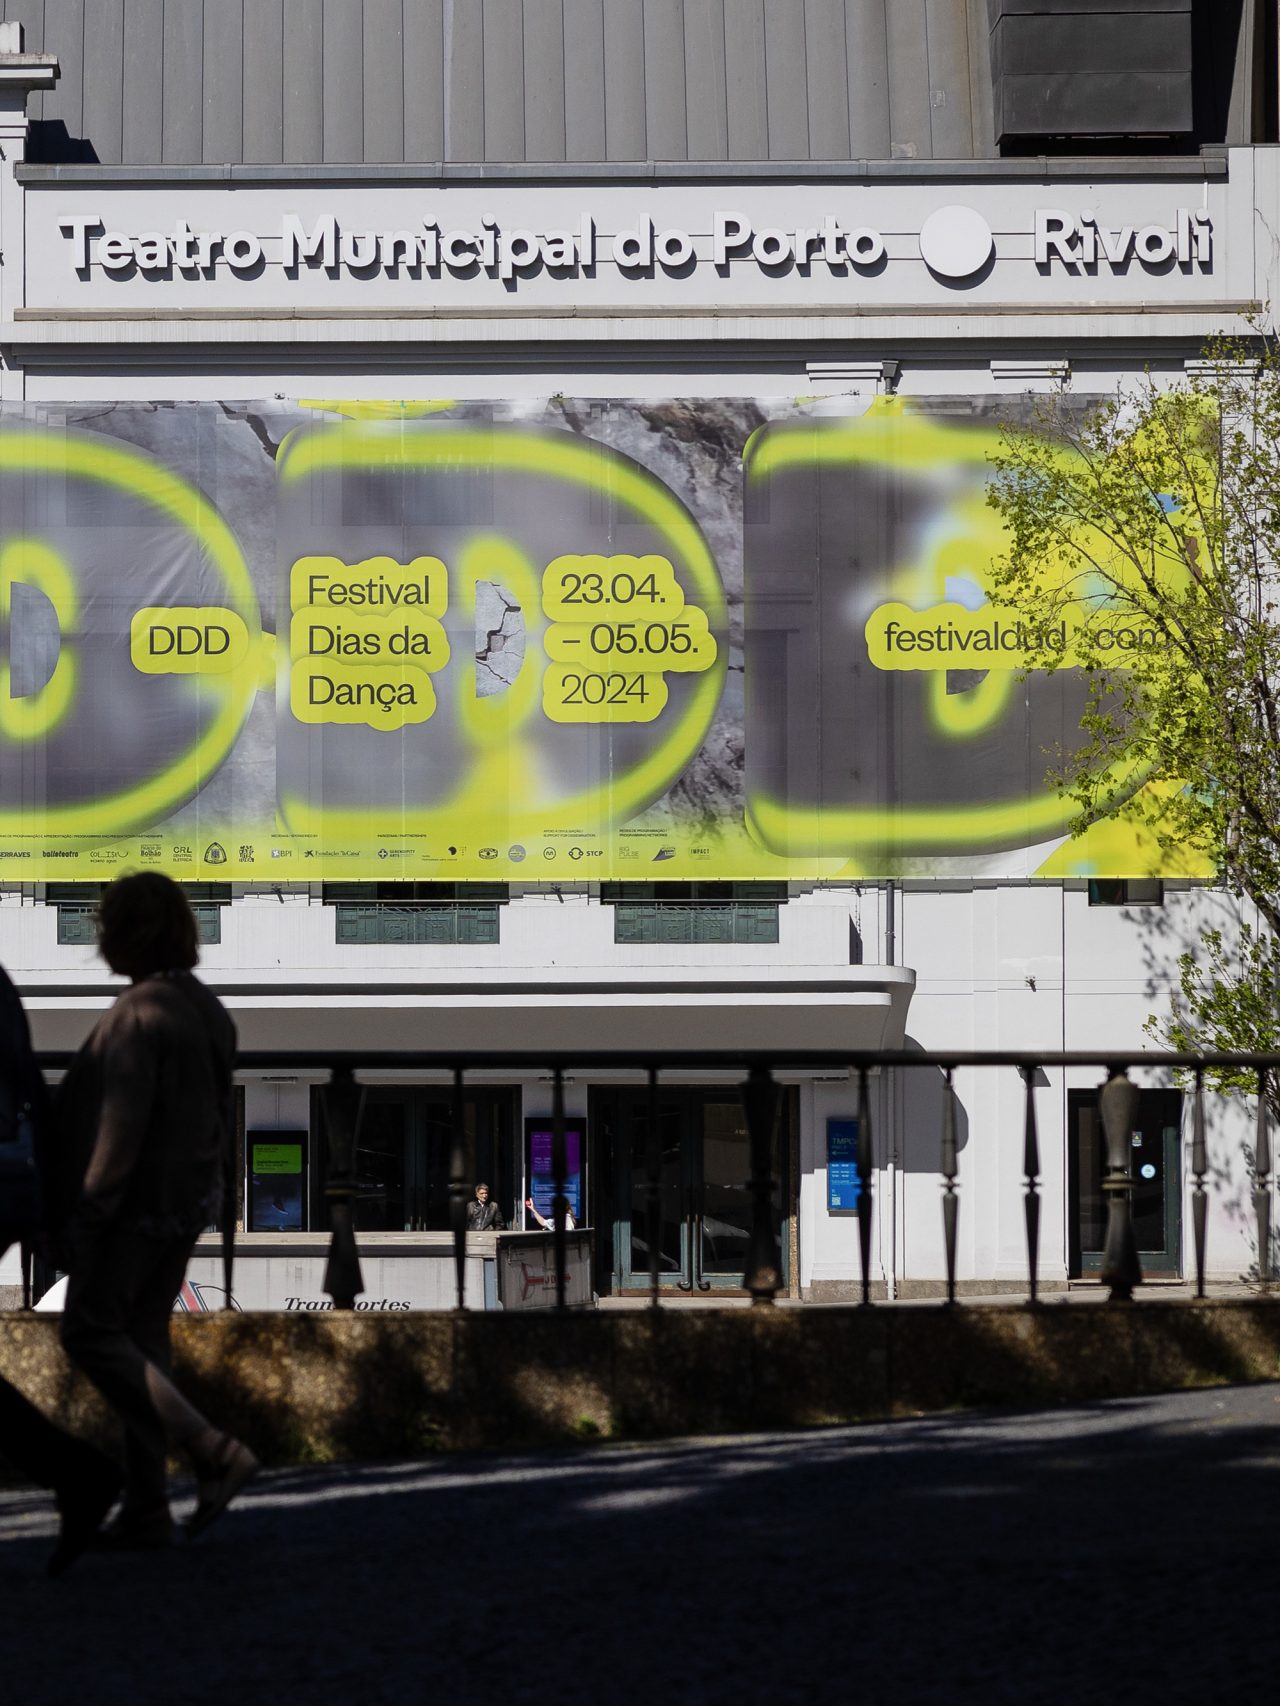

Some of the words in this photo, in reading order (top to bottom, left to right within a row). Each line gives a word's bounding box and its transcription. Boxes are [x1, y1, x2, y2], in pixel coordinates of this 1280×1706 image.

[58, 215, 265, 281] Teatro
[282, 211, 596, 290] Municipal
[611, 212, 696, 279] do
[713, 207, 889, 276] Porto
[1033, 208, 1215, 265] Rivoli
[308, 574, 431, 605] Festival
[561, 574, 666, 604] 23.04.
[149, 625, 231, 655] DDD
[309, 625, 381, 656] Dias
[389, 625, 431, 656] da
[589, 623, 699, 655] 05.05.
[309, 676, 417, 711] Dança
[561, 674, 649, 705] 2024
[284, 1297, 411, 1312] Tranortes
